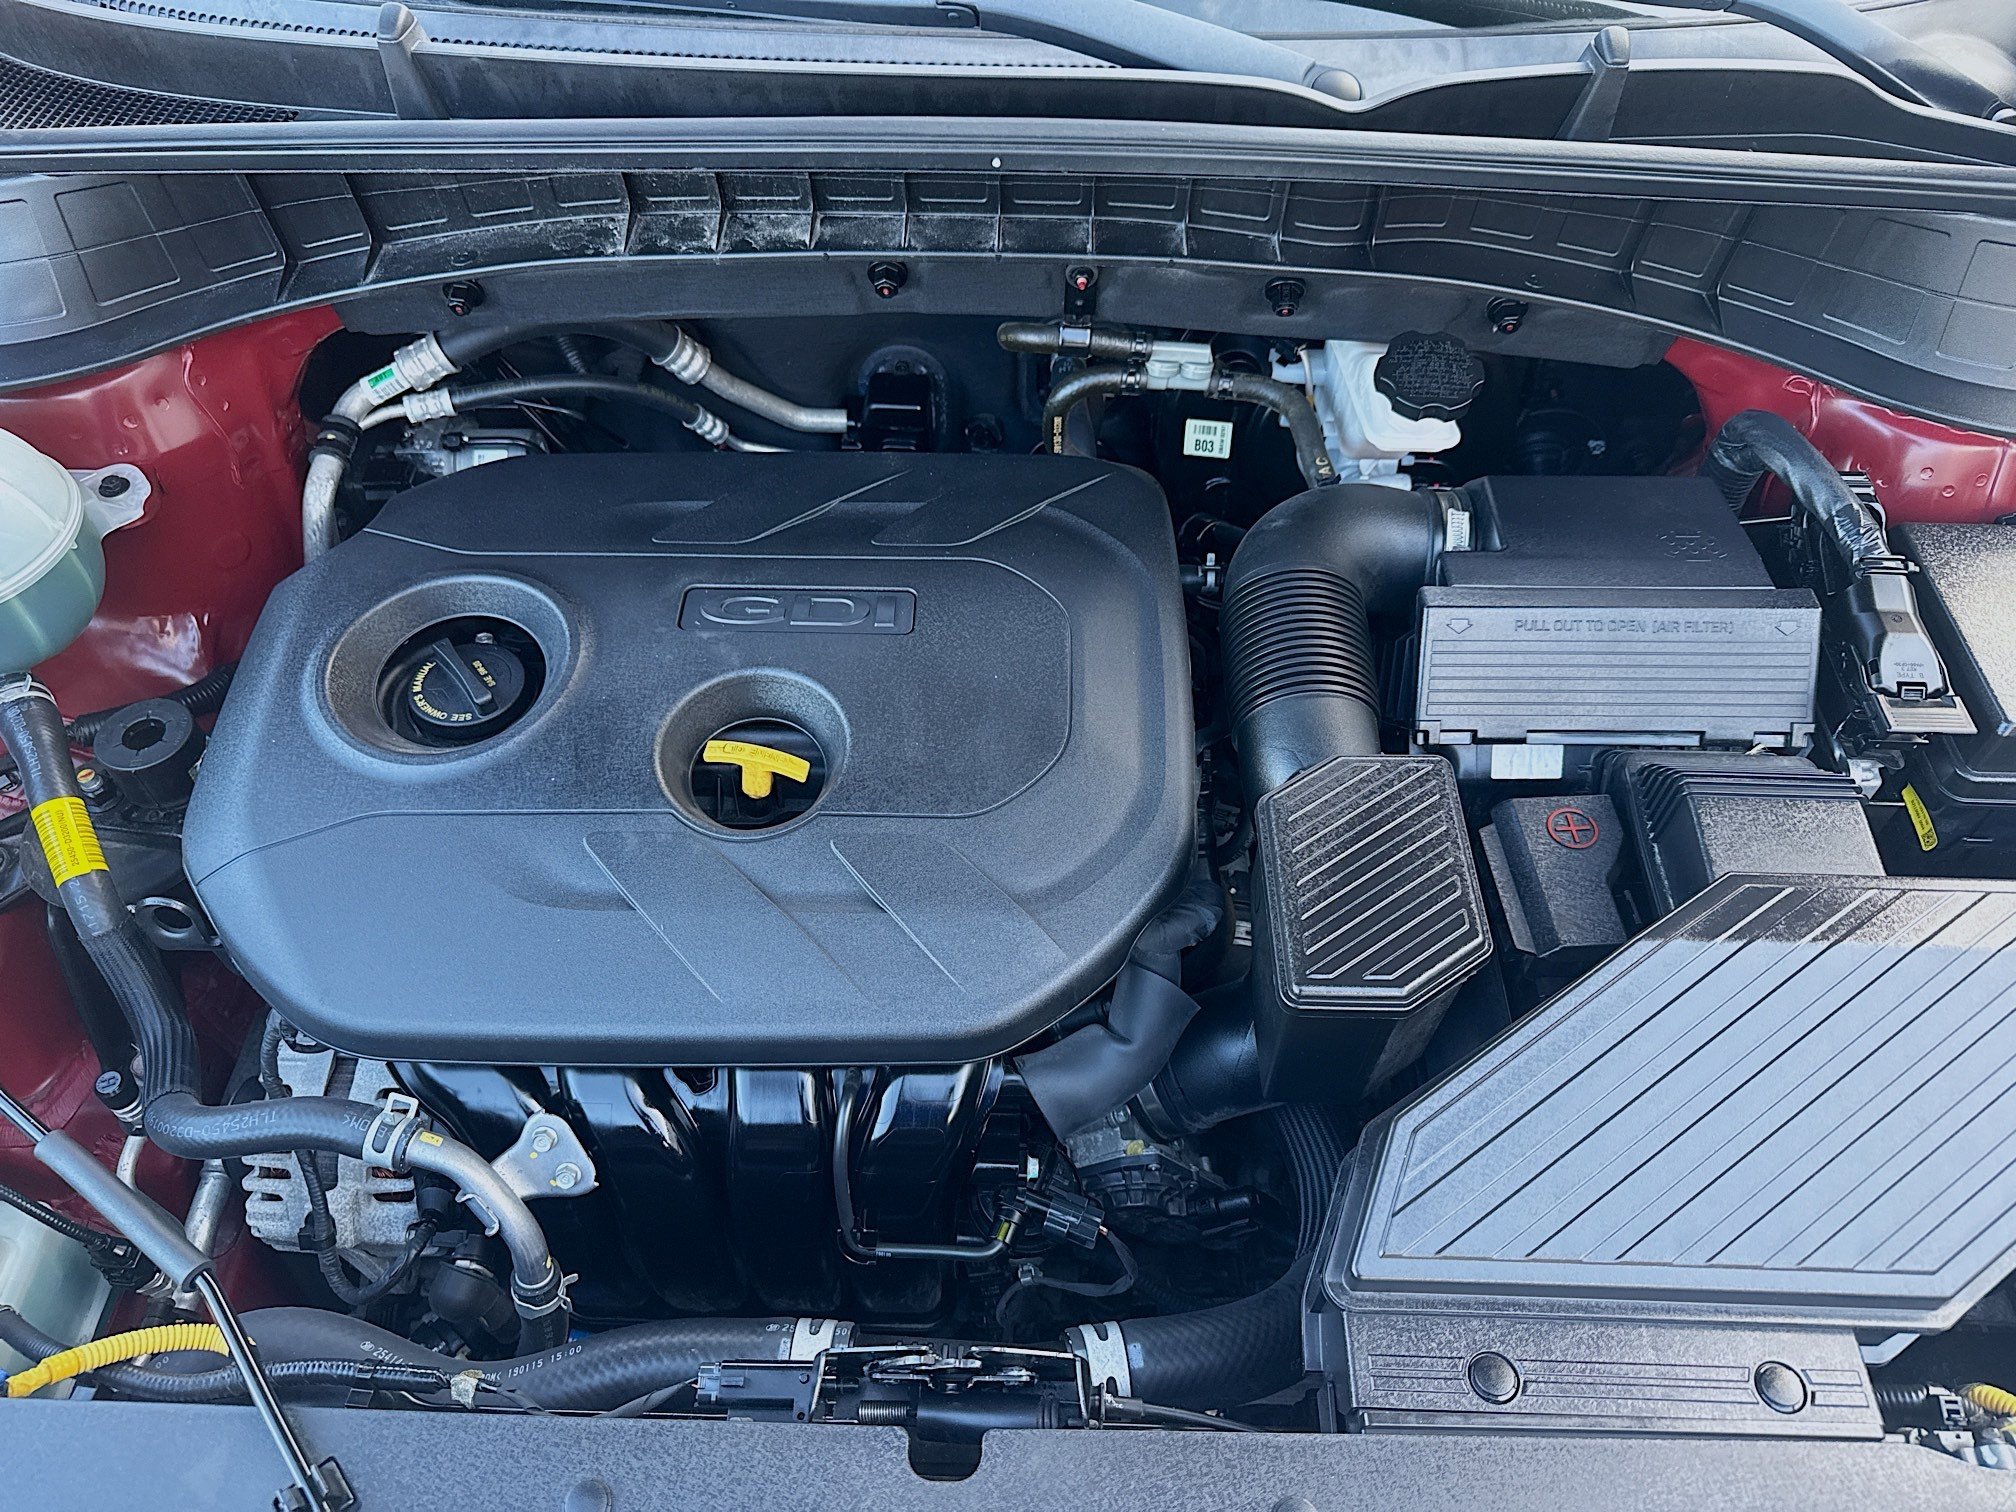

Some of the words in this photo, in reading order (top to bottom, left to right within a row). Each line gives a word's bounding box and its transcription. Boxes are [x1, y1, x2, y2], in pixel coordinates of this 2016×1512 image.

[1194, 439, 1214, 453] B03
[701, 596, 895, 627] GDI
[1514, 619, 1550, 632] PULL
[1553, 619, 1582, 632] OUT
[1586, 619, 1604, 632] TO
[1607, 620, 1646, 632] OPEN
[411, 661, 437, 692] MANUAL
[413, 693, 447, 720] OWNER'S
[450, 712, 472, 722] SEE
[507, 1358, 544, 1379] 190115
[550, 1345, 583, 1363] 15:00
